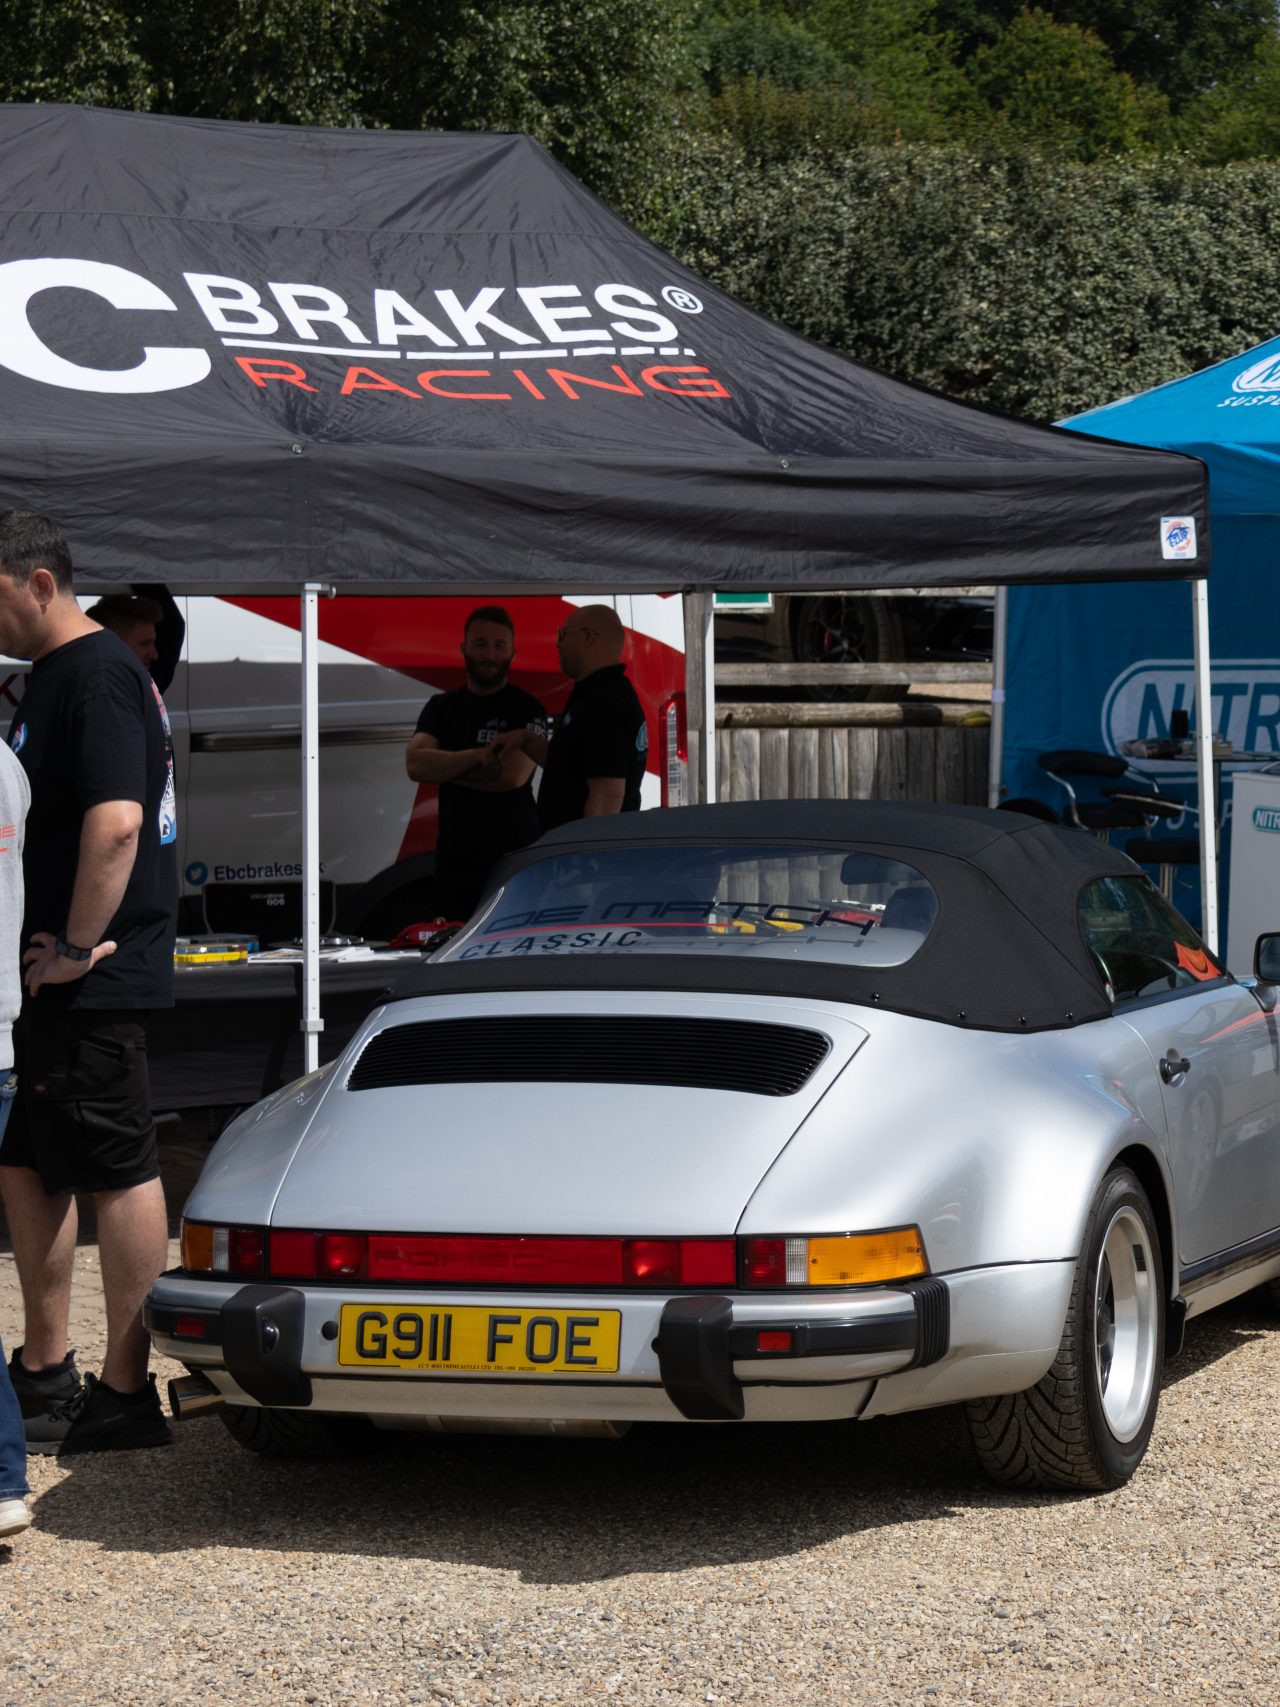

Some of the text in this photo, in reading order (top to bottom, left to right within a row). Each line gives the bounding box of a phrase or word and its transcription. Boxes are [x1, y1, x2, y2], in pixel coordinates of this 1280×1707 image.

[234, 356, 731, 400] RACING
[214, 862, 324, 881] Ebcbrakes
[459, 931, 642, 960] CLASSIC
[355, 1311, 600, 1366] G911 FOE
